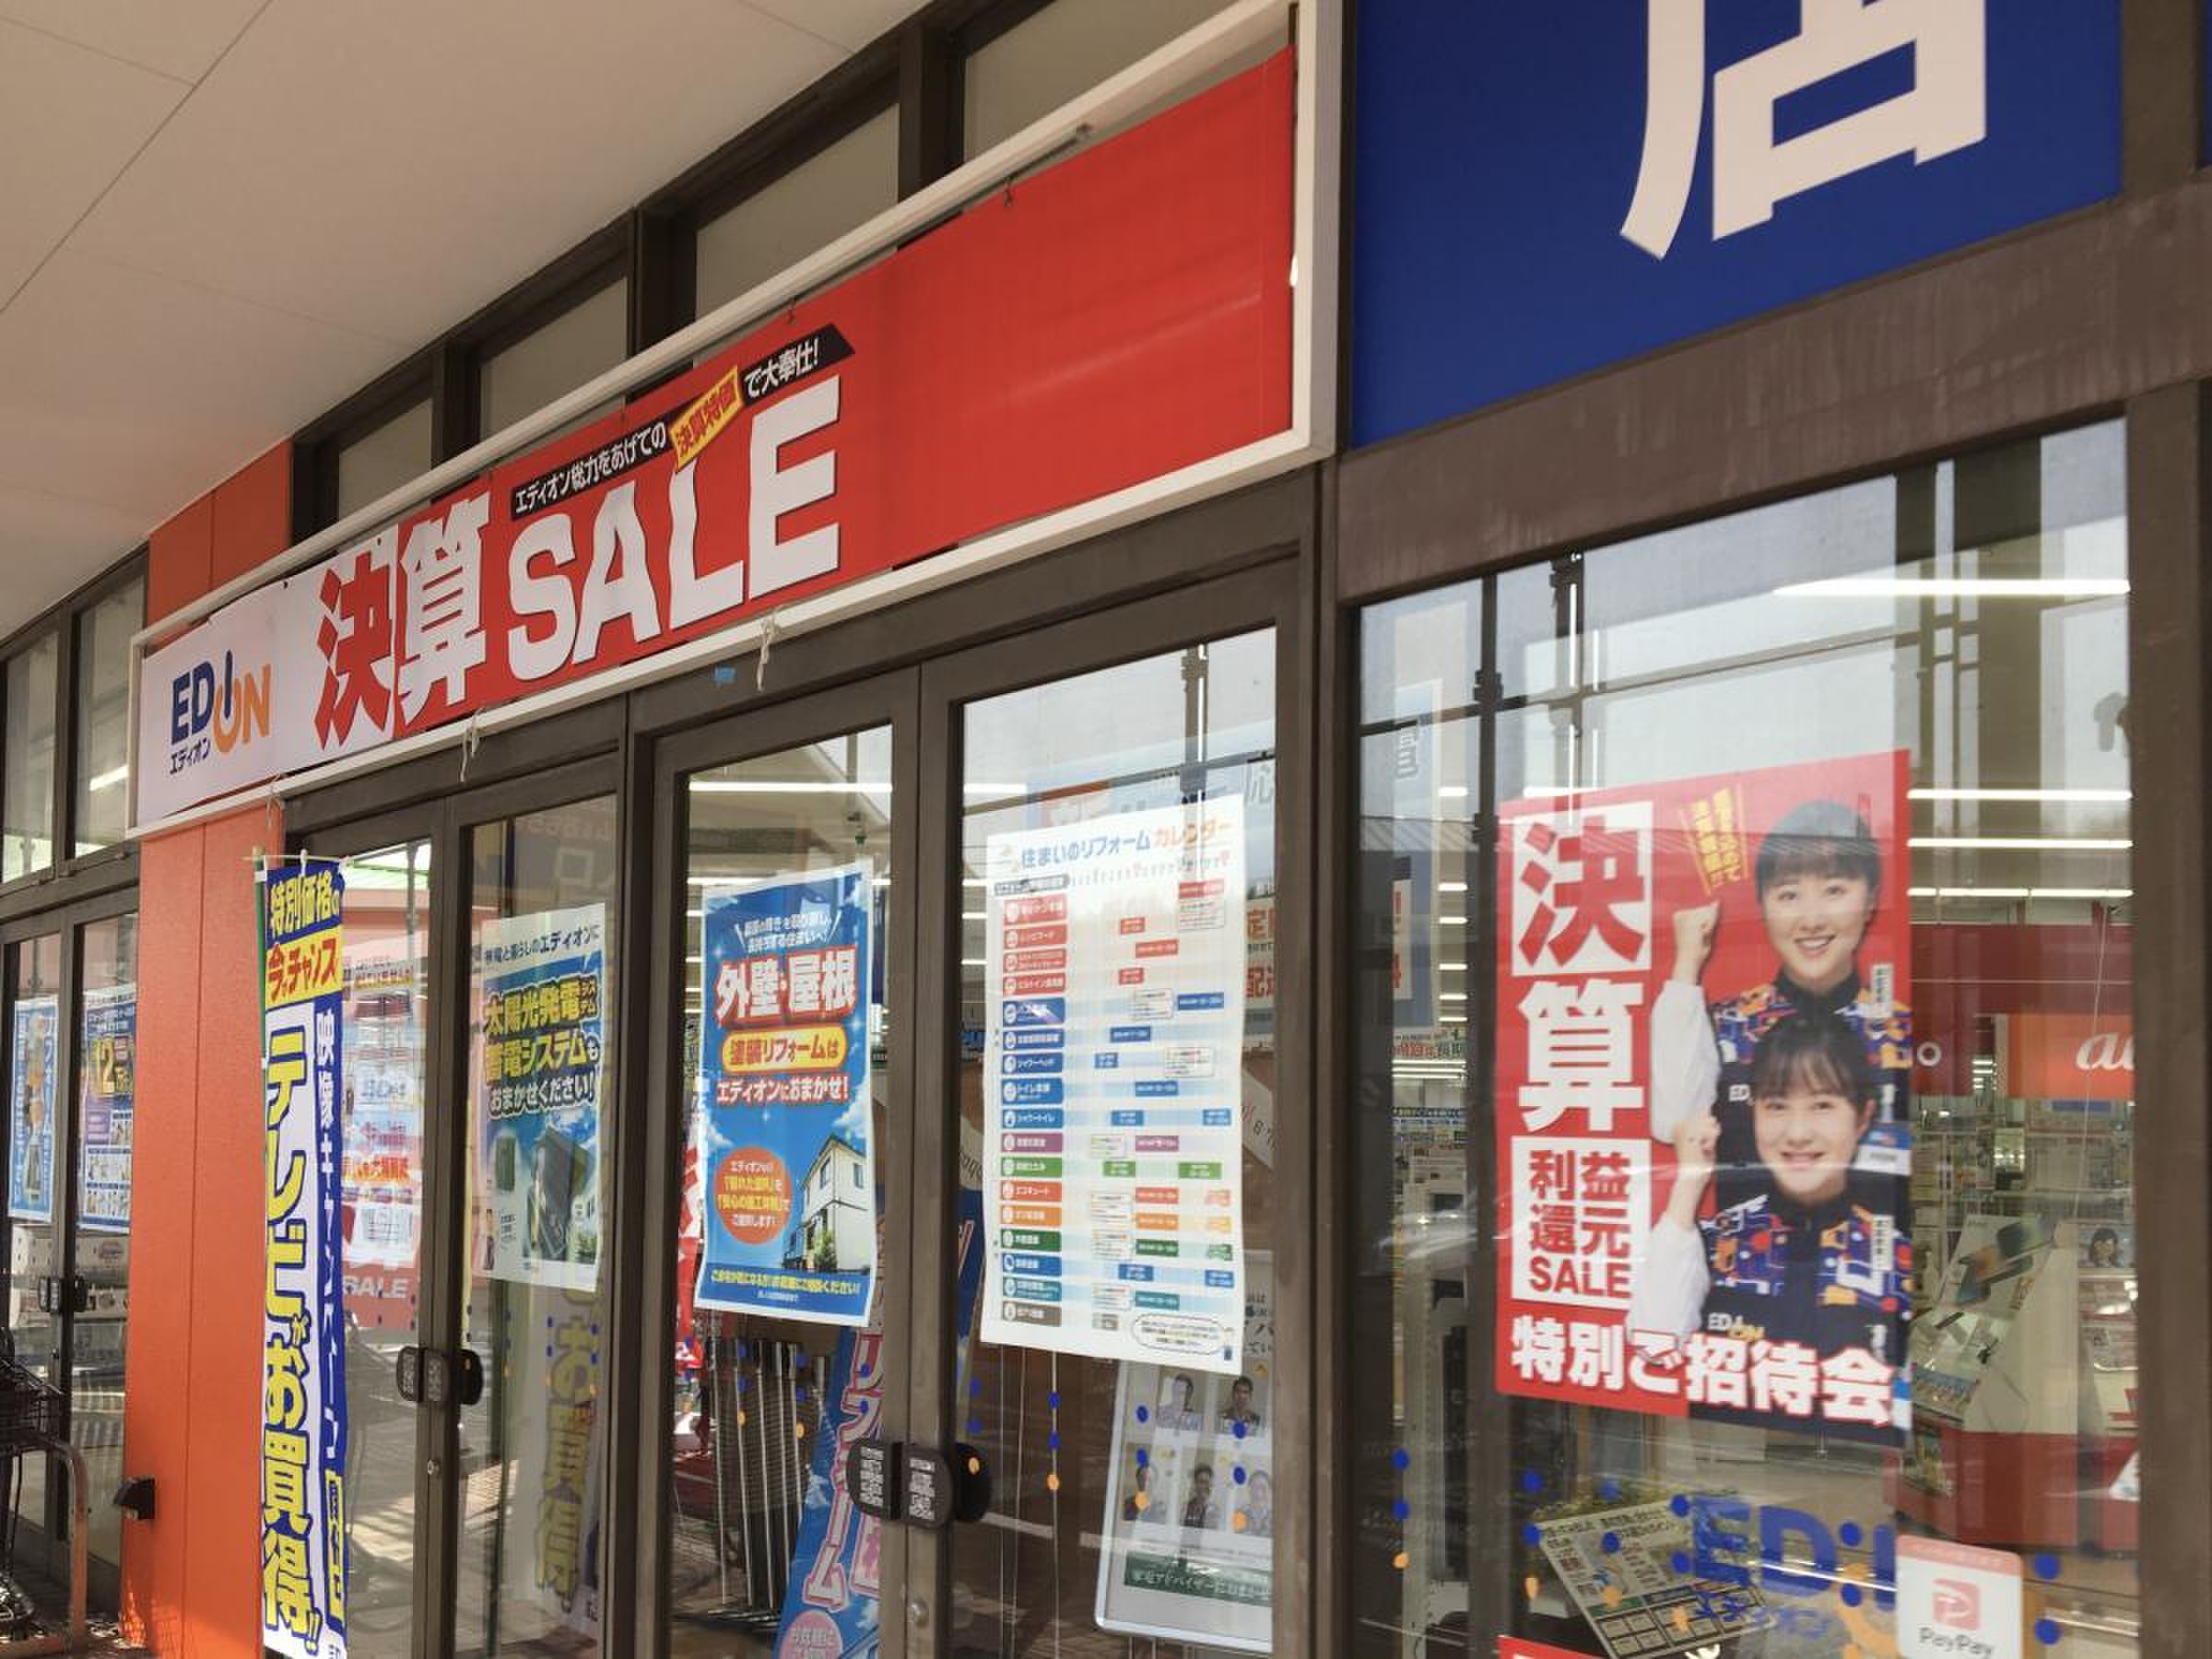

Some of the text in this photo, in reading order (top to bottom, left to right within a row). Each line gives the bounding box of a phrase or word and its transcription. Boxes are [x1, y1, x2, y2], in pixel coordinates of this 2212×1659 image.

[514, 420, 667, 514] エディオン総力をあげての
[507, 374, 841, 682] SALE
[313, 488, 491, 754] 決算
[171, 650, 271, 753] EDION
[169, 737, 211, 776] エディオン
[1529, 1255, 1632, 1299] SALE
[1510, 1313, 1897, 1427] 特別ご招待会
